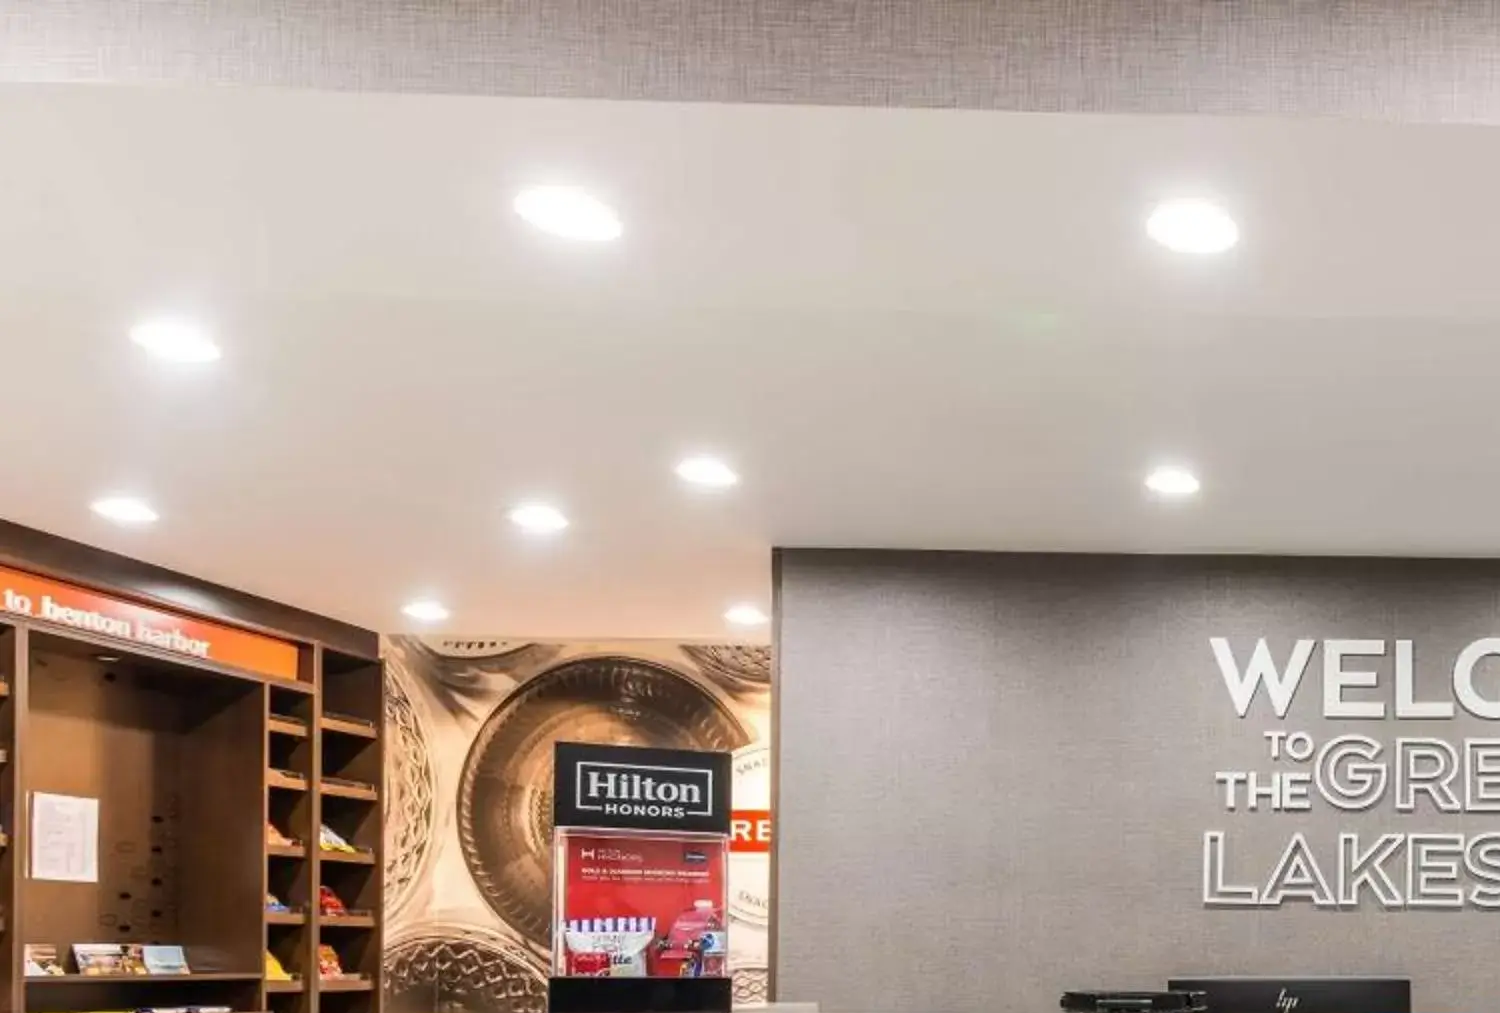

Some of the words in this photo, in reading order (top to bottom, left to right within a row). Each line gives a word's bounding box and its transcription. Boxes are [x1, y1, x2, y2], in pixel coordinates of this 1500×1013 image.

[3, 588, 32, 616] to
[41, 595, 131, 638] benton
[136, 621, 211, 658] harbor
[1263, 729, 1315, 760] TO
[587, 770, 701, 803] Hilton
[1214, 770, 1312, 810] THE
[604, 803, 685, 818] HONORS
